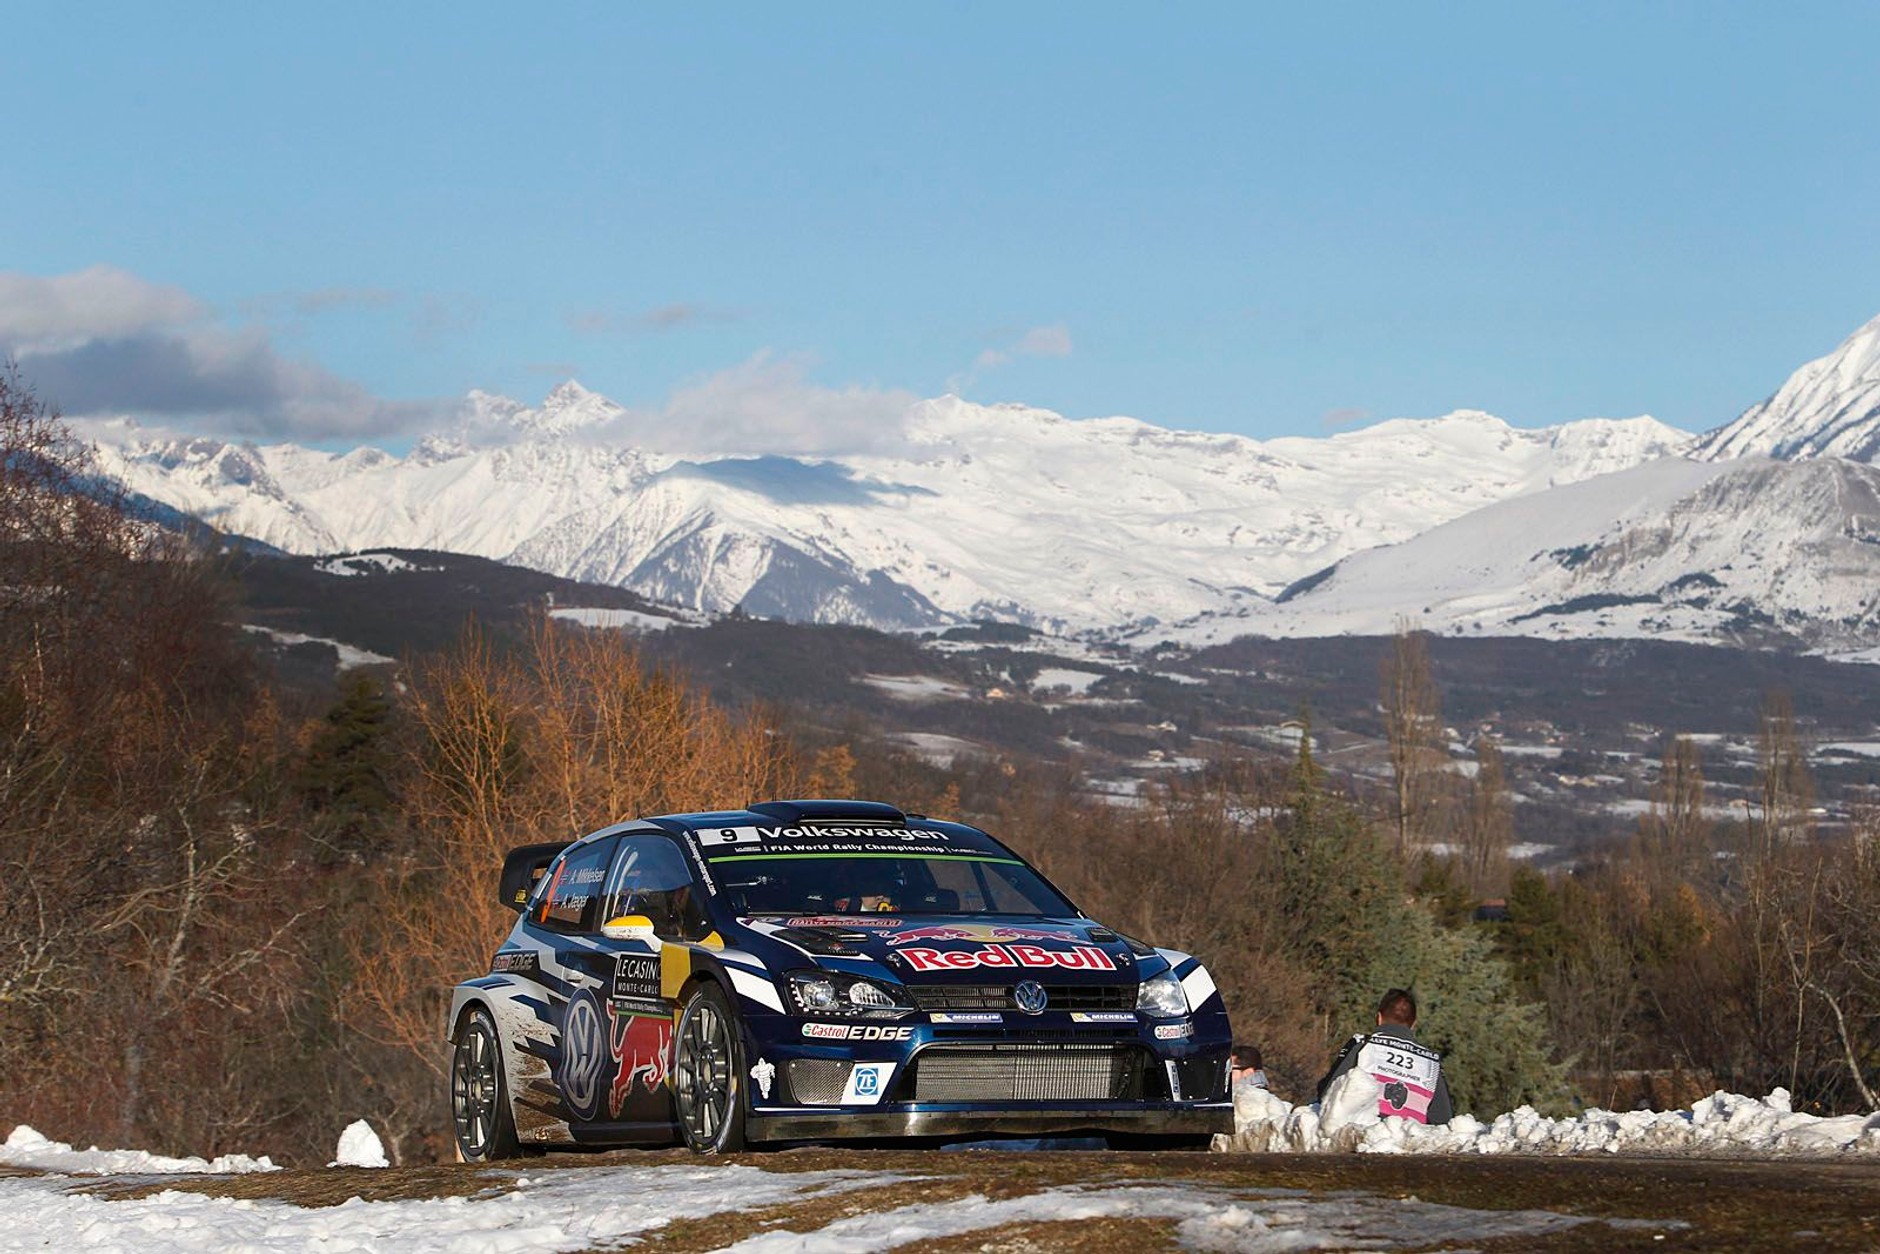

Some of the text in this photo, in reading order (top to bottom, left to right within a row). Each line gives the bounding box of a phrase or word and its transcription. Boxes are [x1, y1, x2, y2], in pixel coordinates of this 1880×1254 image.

[720, 828, 738, 842] 9
[758, 826, 949, 840] Volkswagen
[770, 844, 792, 852] FIA
[833, 843, 862, 851] Rally
[865, 844, 945, 853] Championship
[899, 945, 1116, 970] Red Bull
[811, 1024, 915, 1040] Castrol EDGE
[1386, 1051, 1414, 1070] 223
[1377, 1065, 1421, 1081] PHOTOGRAPHER
[858, 1074, 877, 1088] ZF
